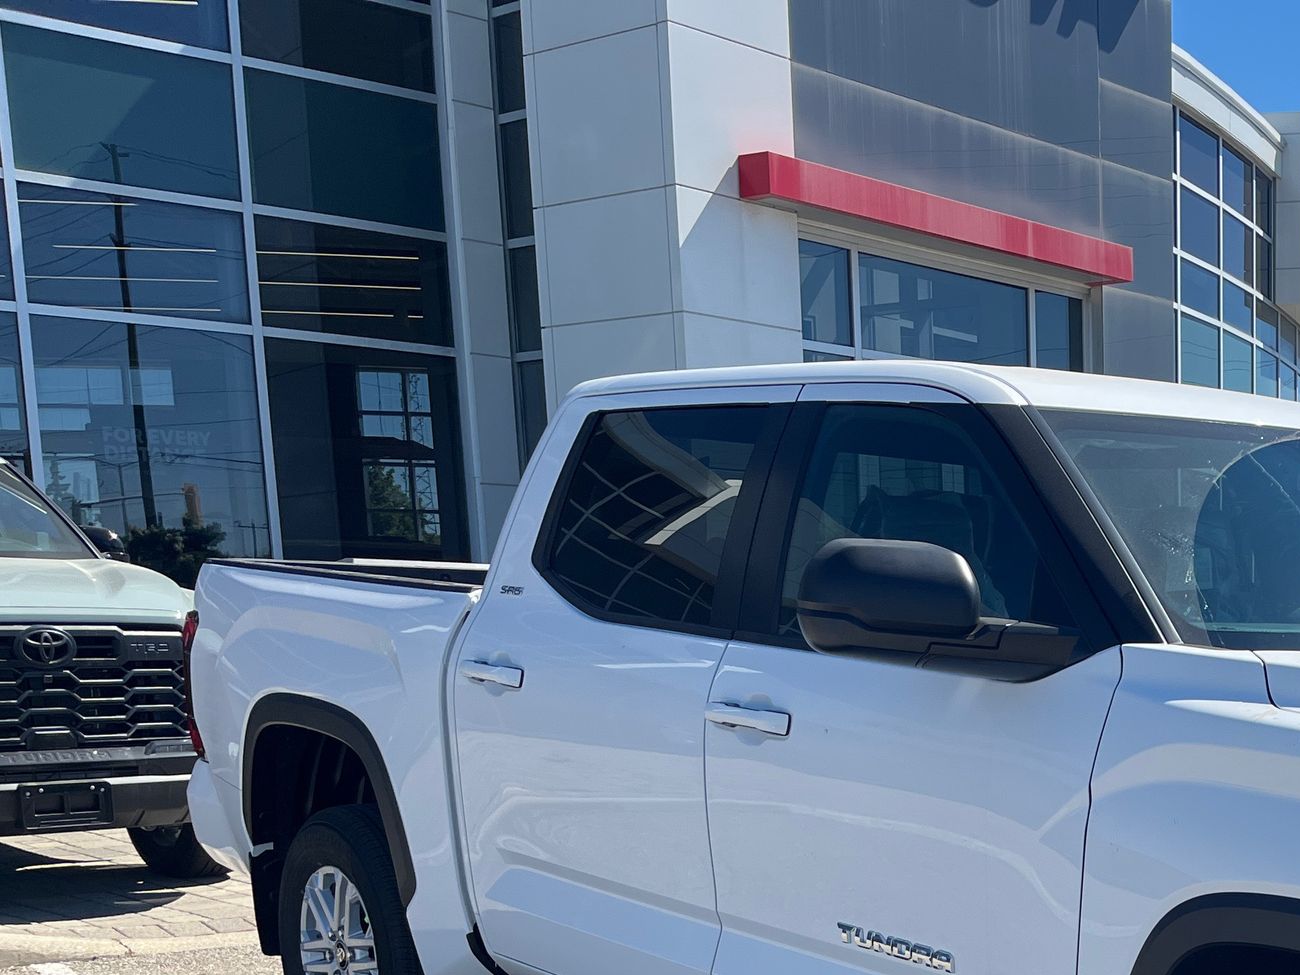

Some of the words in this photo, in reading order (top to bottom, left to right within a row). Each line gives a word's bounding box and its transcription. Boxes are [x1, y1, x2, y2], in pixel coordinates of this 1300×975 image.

[101, 426, 144, 444] FOR
[148, 428, 211, 447] EVERY
[836, 921, 955, 974] TUNDRA
